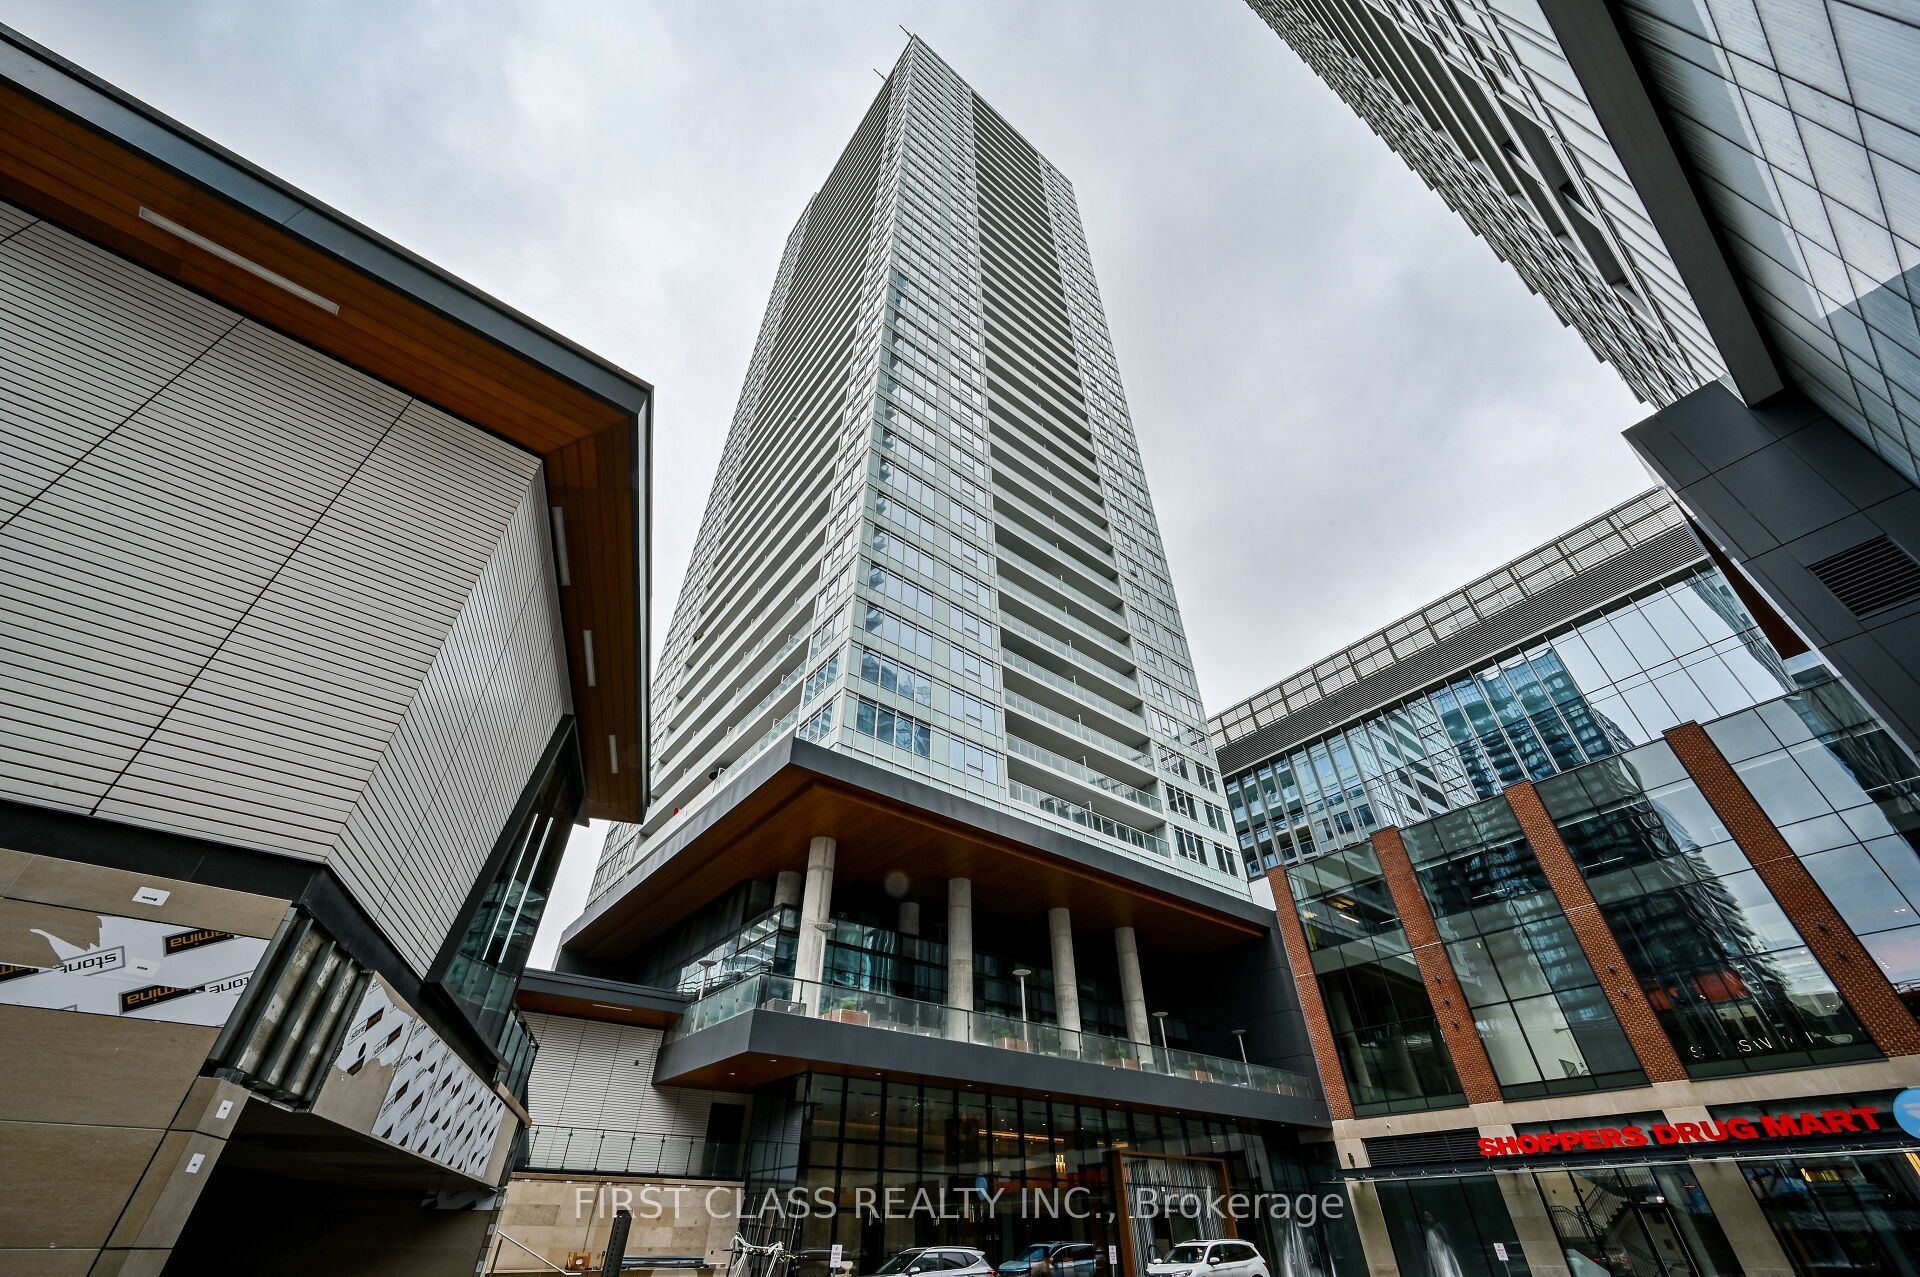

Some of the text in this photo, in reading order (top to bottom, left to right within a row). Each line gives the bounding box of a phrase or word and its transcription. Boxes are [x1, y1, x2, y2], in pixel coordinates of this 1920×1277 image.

[208, 976, 249, 994] tone
[1477, 1107, 1880, 1157] SHOPPERS DRUG MART
